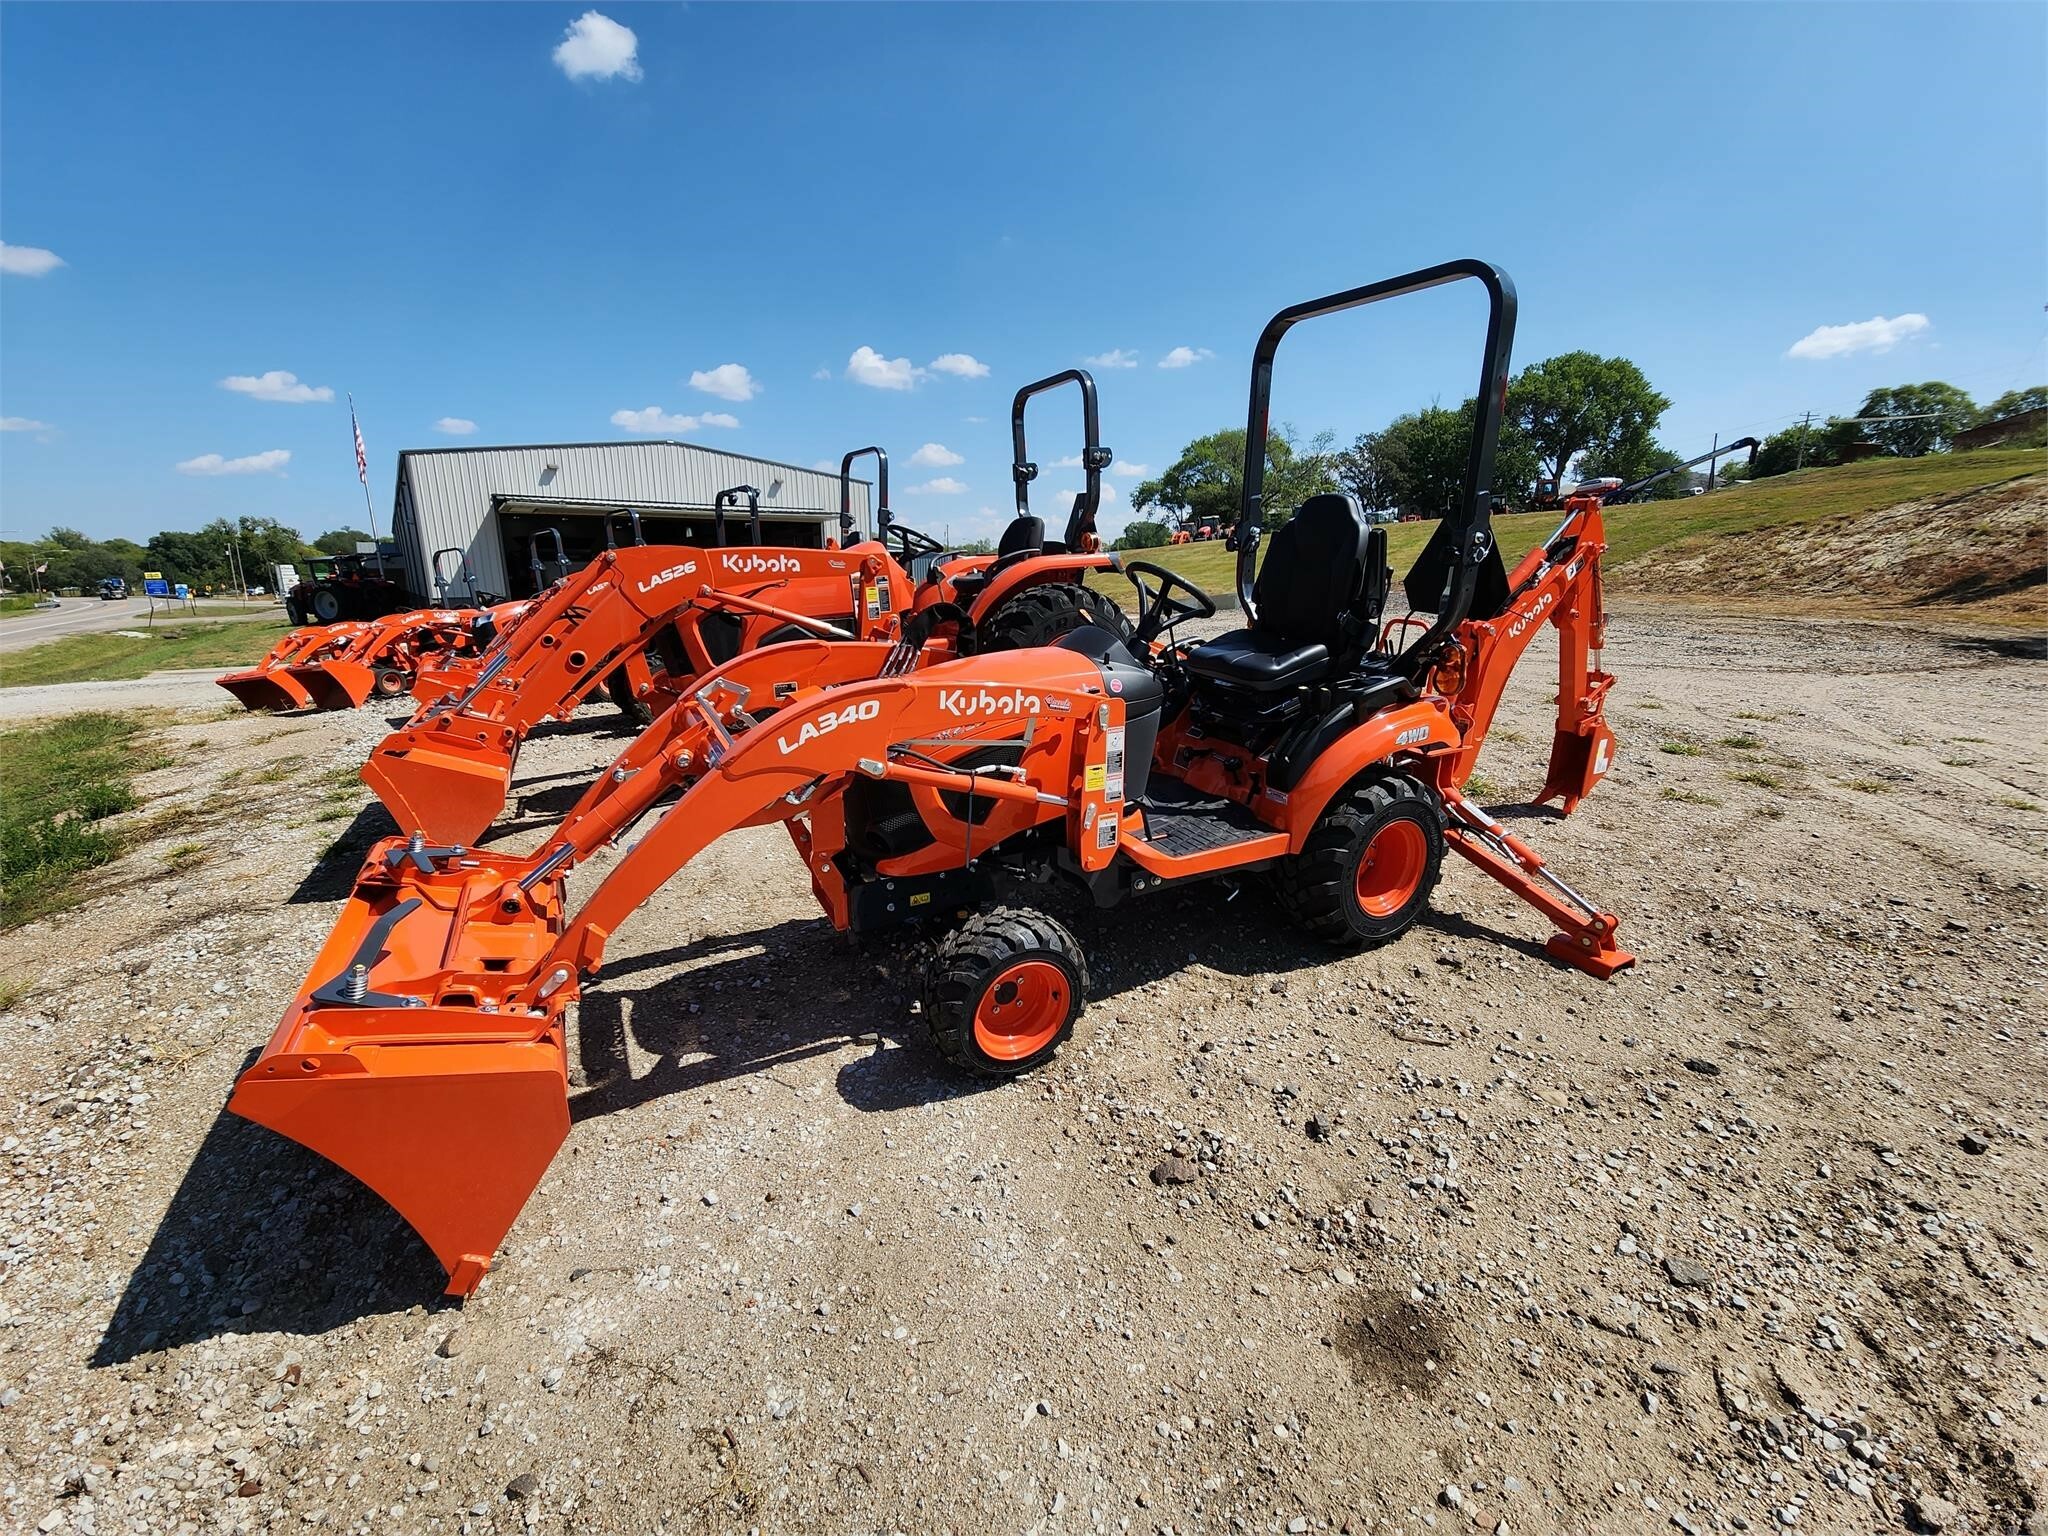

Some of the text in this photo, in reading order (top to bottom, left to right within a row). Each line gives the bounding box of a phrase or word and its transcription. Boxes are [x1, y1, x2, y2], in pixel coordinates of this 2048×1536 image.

[637, 560, 697, 594] LA526
[722, 553, 801, 574] Kubota
[1508, 592, 1554, 640] Kubota
[938, 688, 1041, 718] Kubota
[776, 699, 881, 756] LA340
[1394, 724, 1431, 746] 4WD
